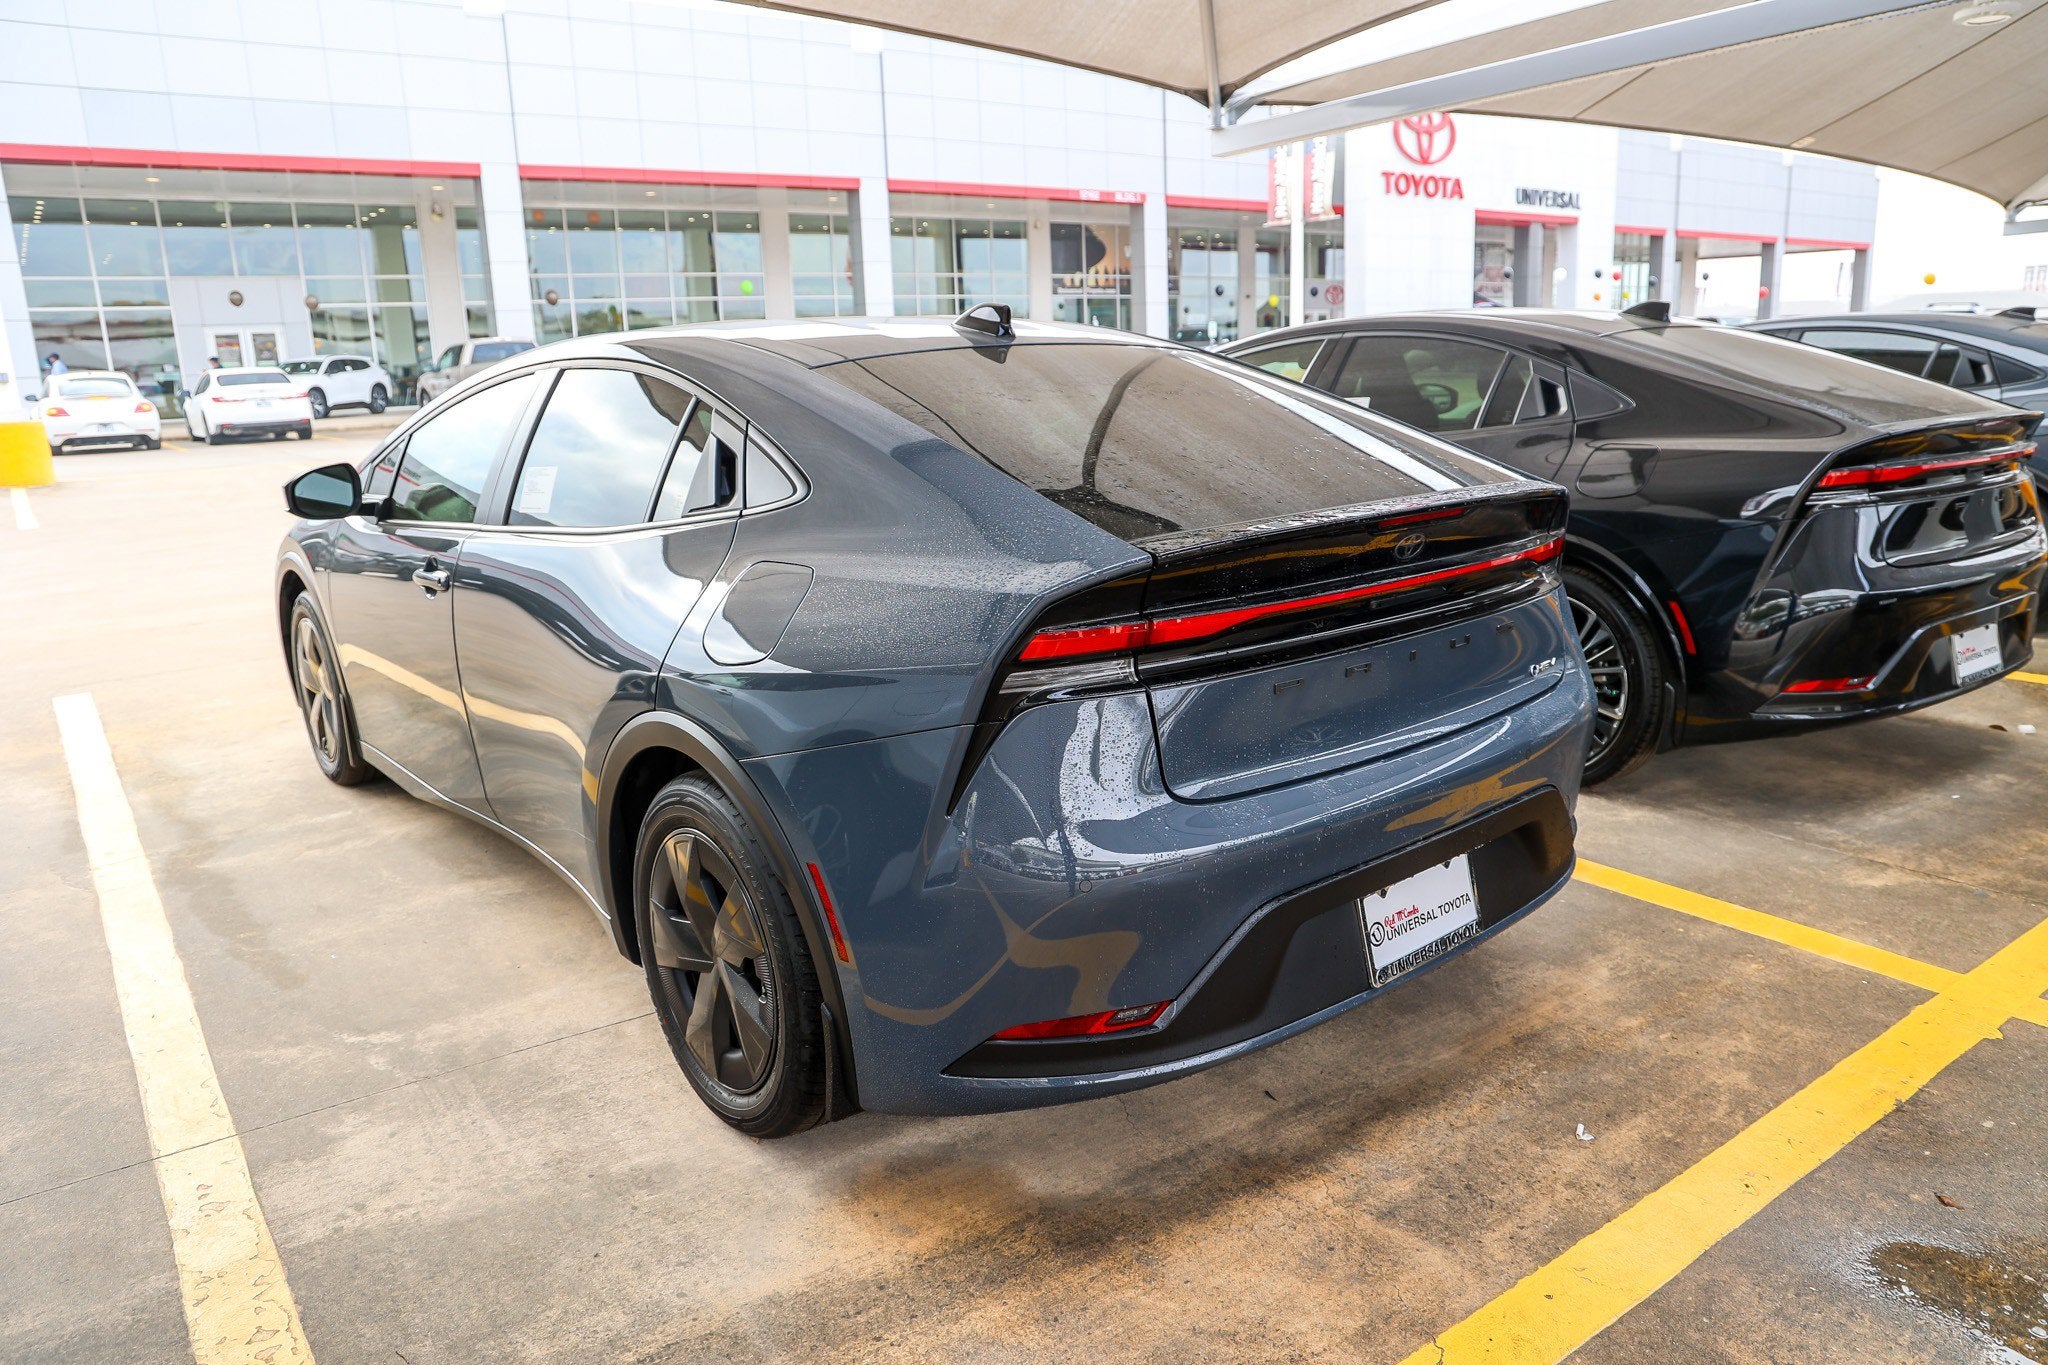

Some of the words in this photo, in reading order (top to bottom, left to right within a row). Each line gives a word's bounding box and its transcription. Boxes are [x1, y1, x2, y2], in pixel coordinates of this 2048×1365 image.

[1381, 172, 1464, 200] TOYOTA
[1515, 187, 1581, 210] UNIVERSAL
[1386, 909, 1439, 941] UNIVERSAL
[1438, 892, 1472, 917] TOYOTA
[1390, 939, 1446, 976] UNIVERSAL
[1445, 921, 1481, 948] TOYOTA
